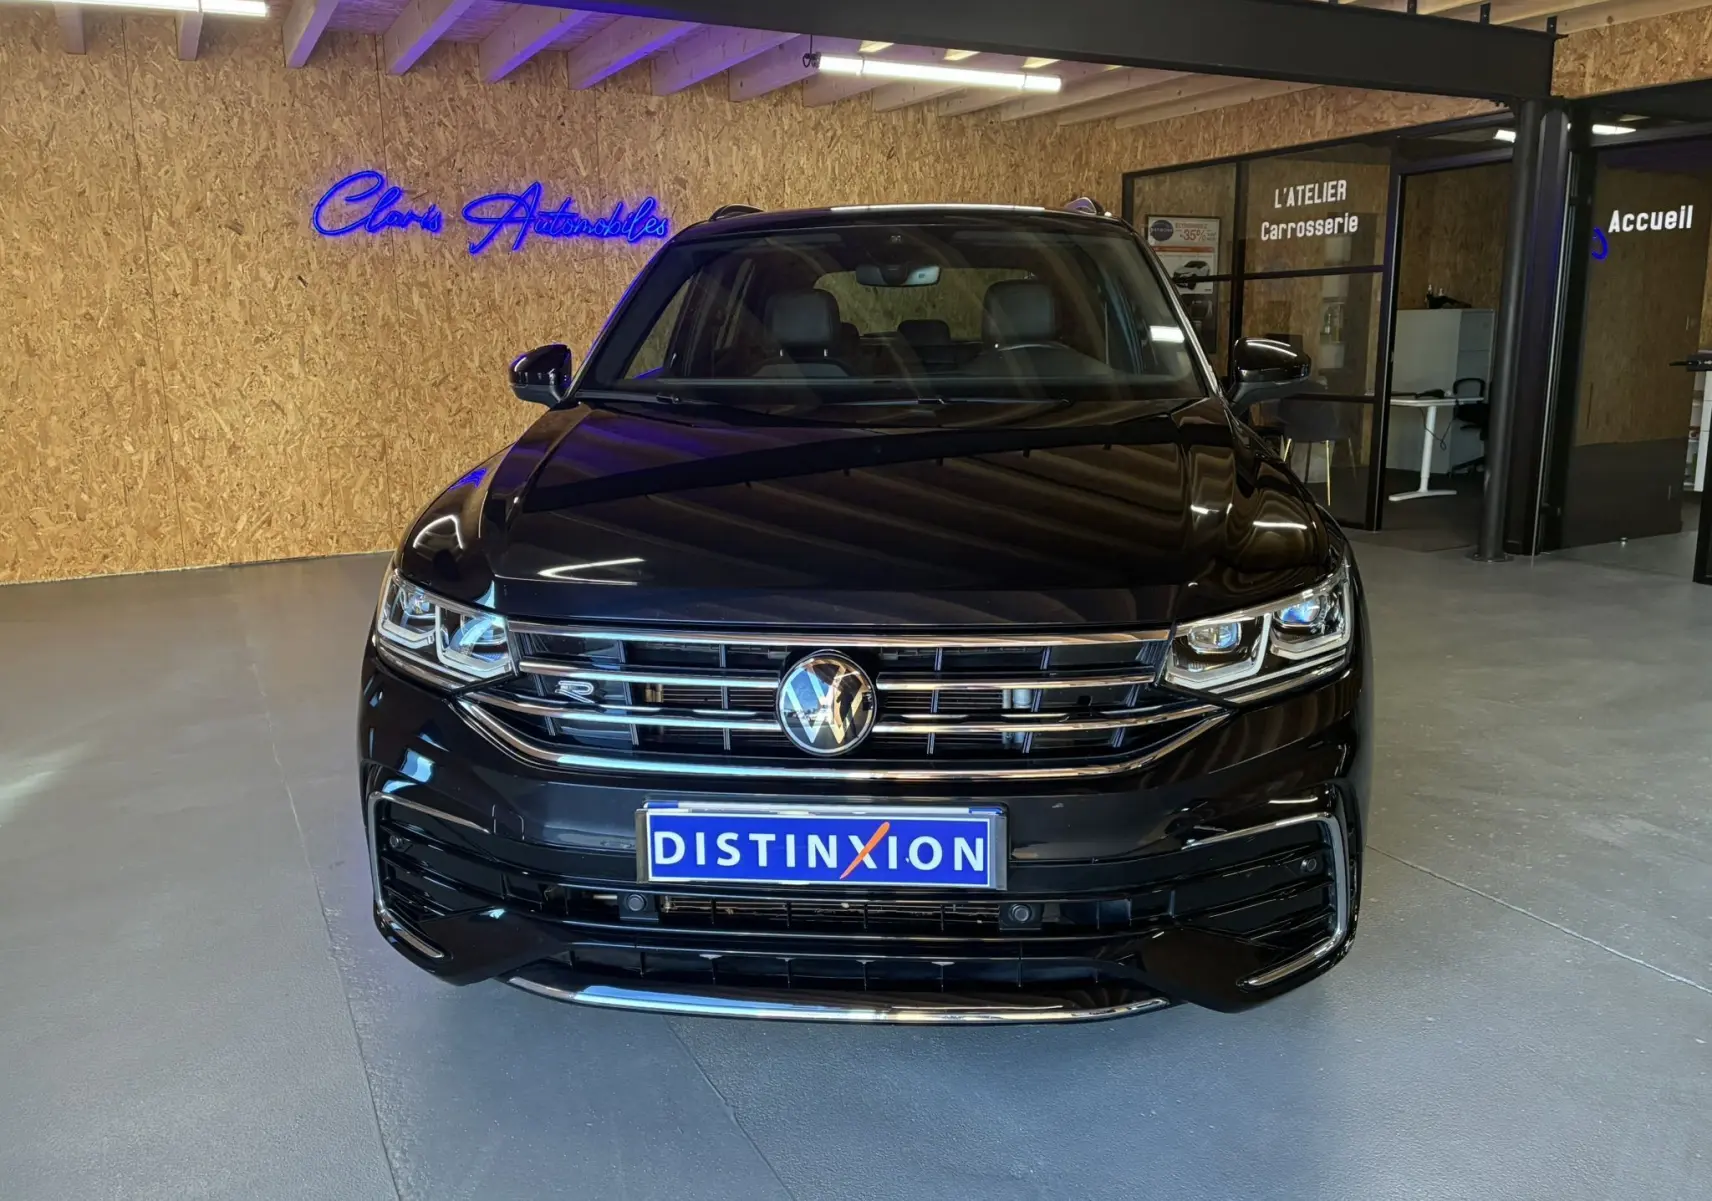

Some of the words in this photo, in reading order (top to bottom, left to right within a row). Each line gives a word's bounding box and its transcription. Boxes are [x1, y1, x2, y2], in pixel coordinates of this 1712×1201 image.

[1274, 180, 1347, 209] L'ATELIER
[313, 170, 442, 236] Claris
[462, 181, 668, 254] Automobiles
[1261, 212, 1359, 241] Carrosserie
[1608, 205, 1693, 233] Accueil
[653, 822, 984, 880] DISTINXION
